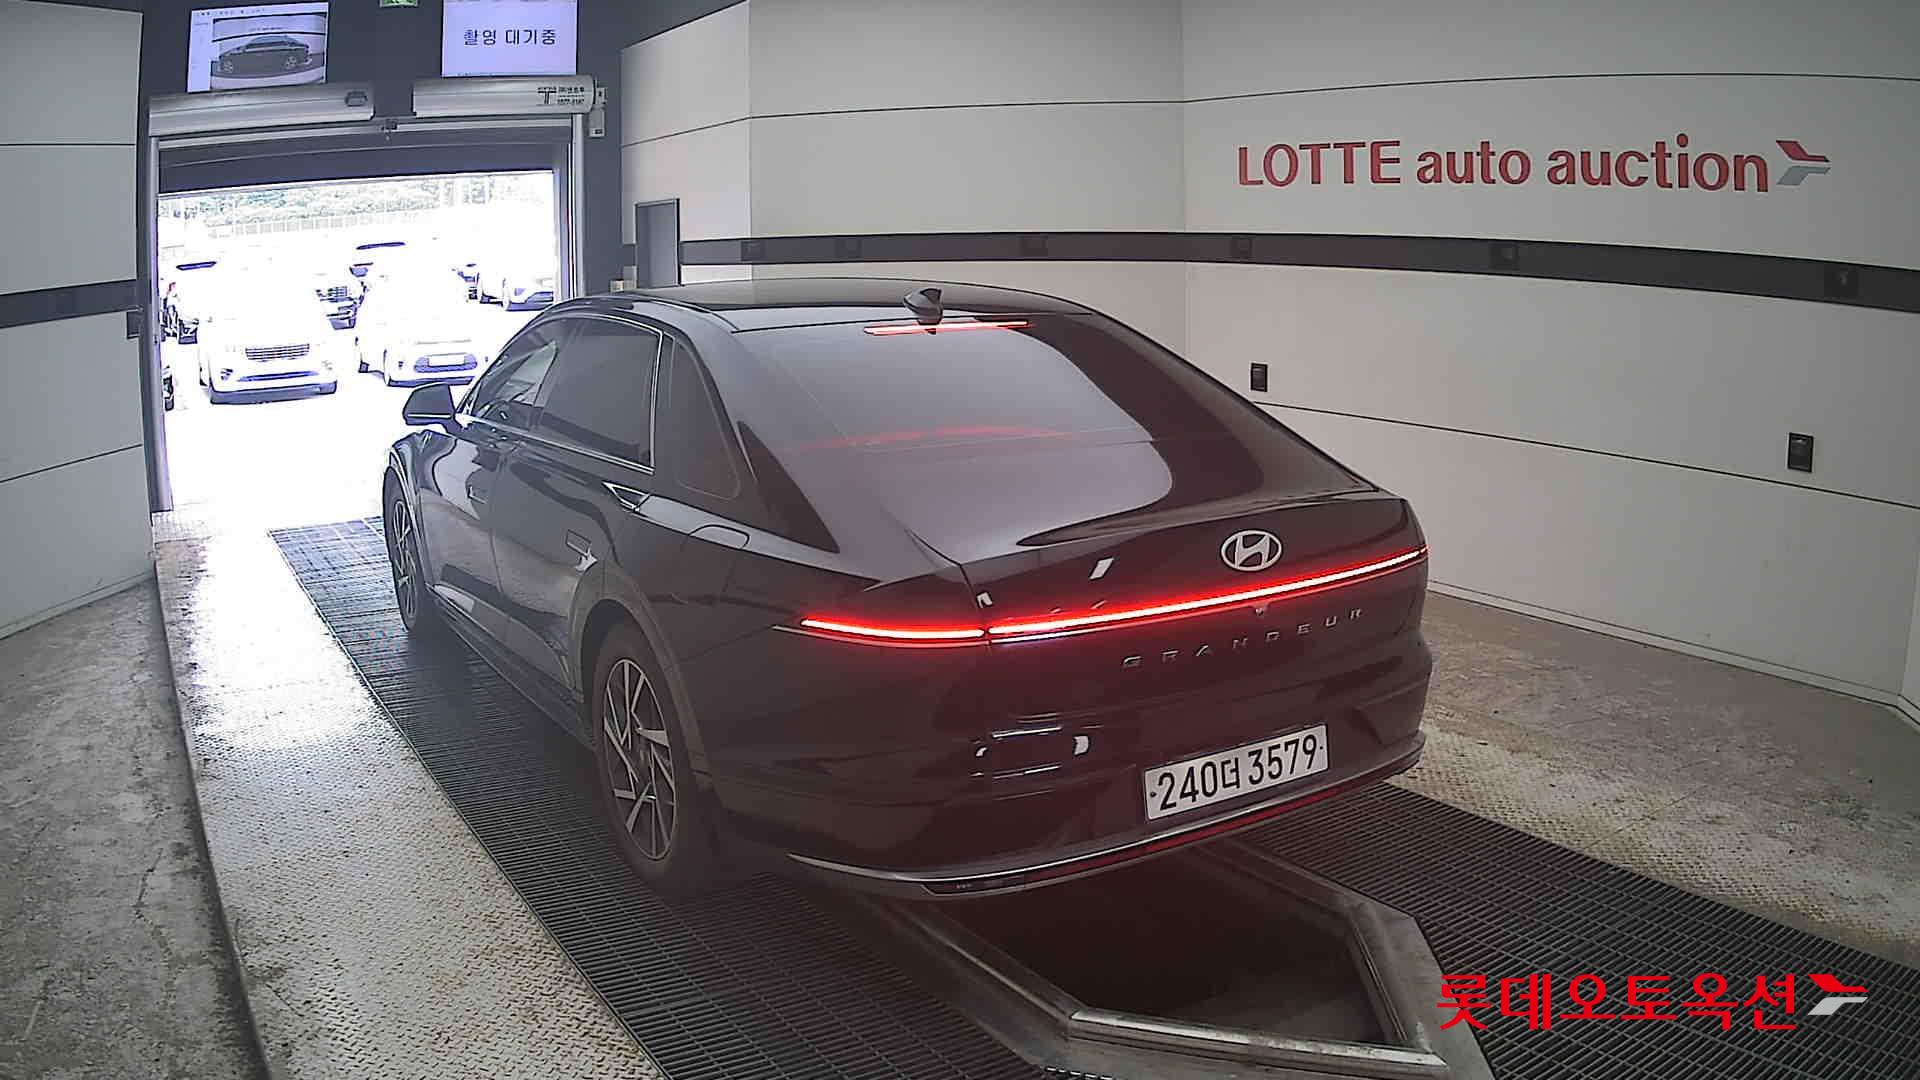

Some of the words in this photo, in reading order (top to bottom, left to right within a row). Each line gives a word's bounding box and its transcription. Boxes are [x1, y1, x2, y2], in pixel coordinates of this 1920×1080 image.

[505, 29, 556, 46] 대기중
[1238, 140, 1401, 187] LOTTE
[1416, 141, 1531, 185] auto
[1547, 133, 1769, 193] auction
[1121, 608, 1362, 668] GRANDEUR
[1157, 757, 1241, 812] 240더
[1247, 734, 1318, 785] 3579
